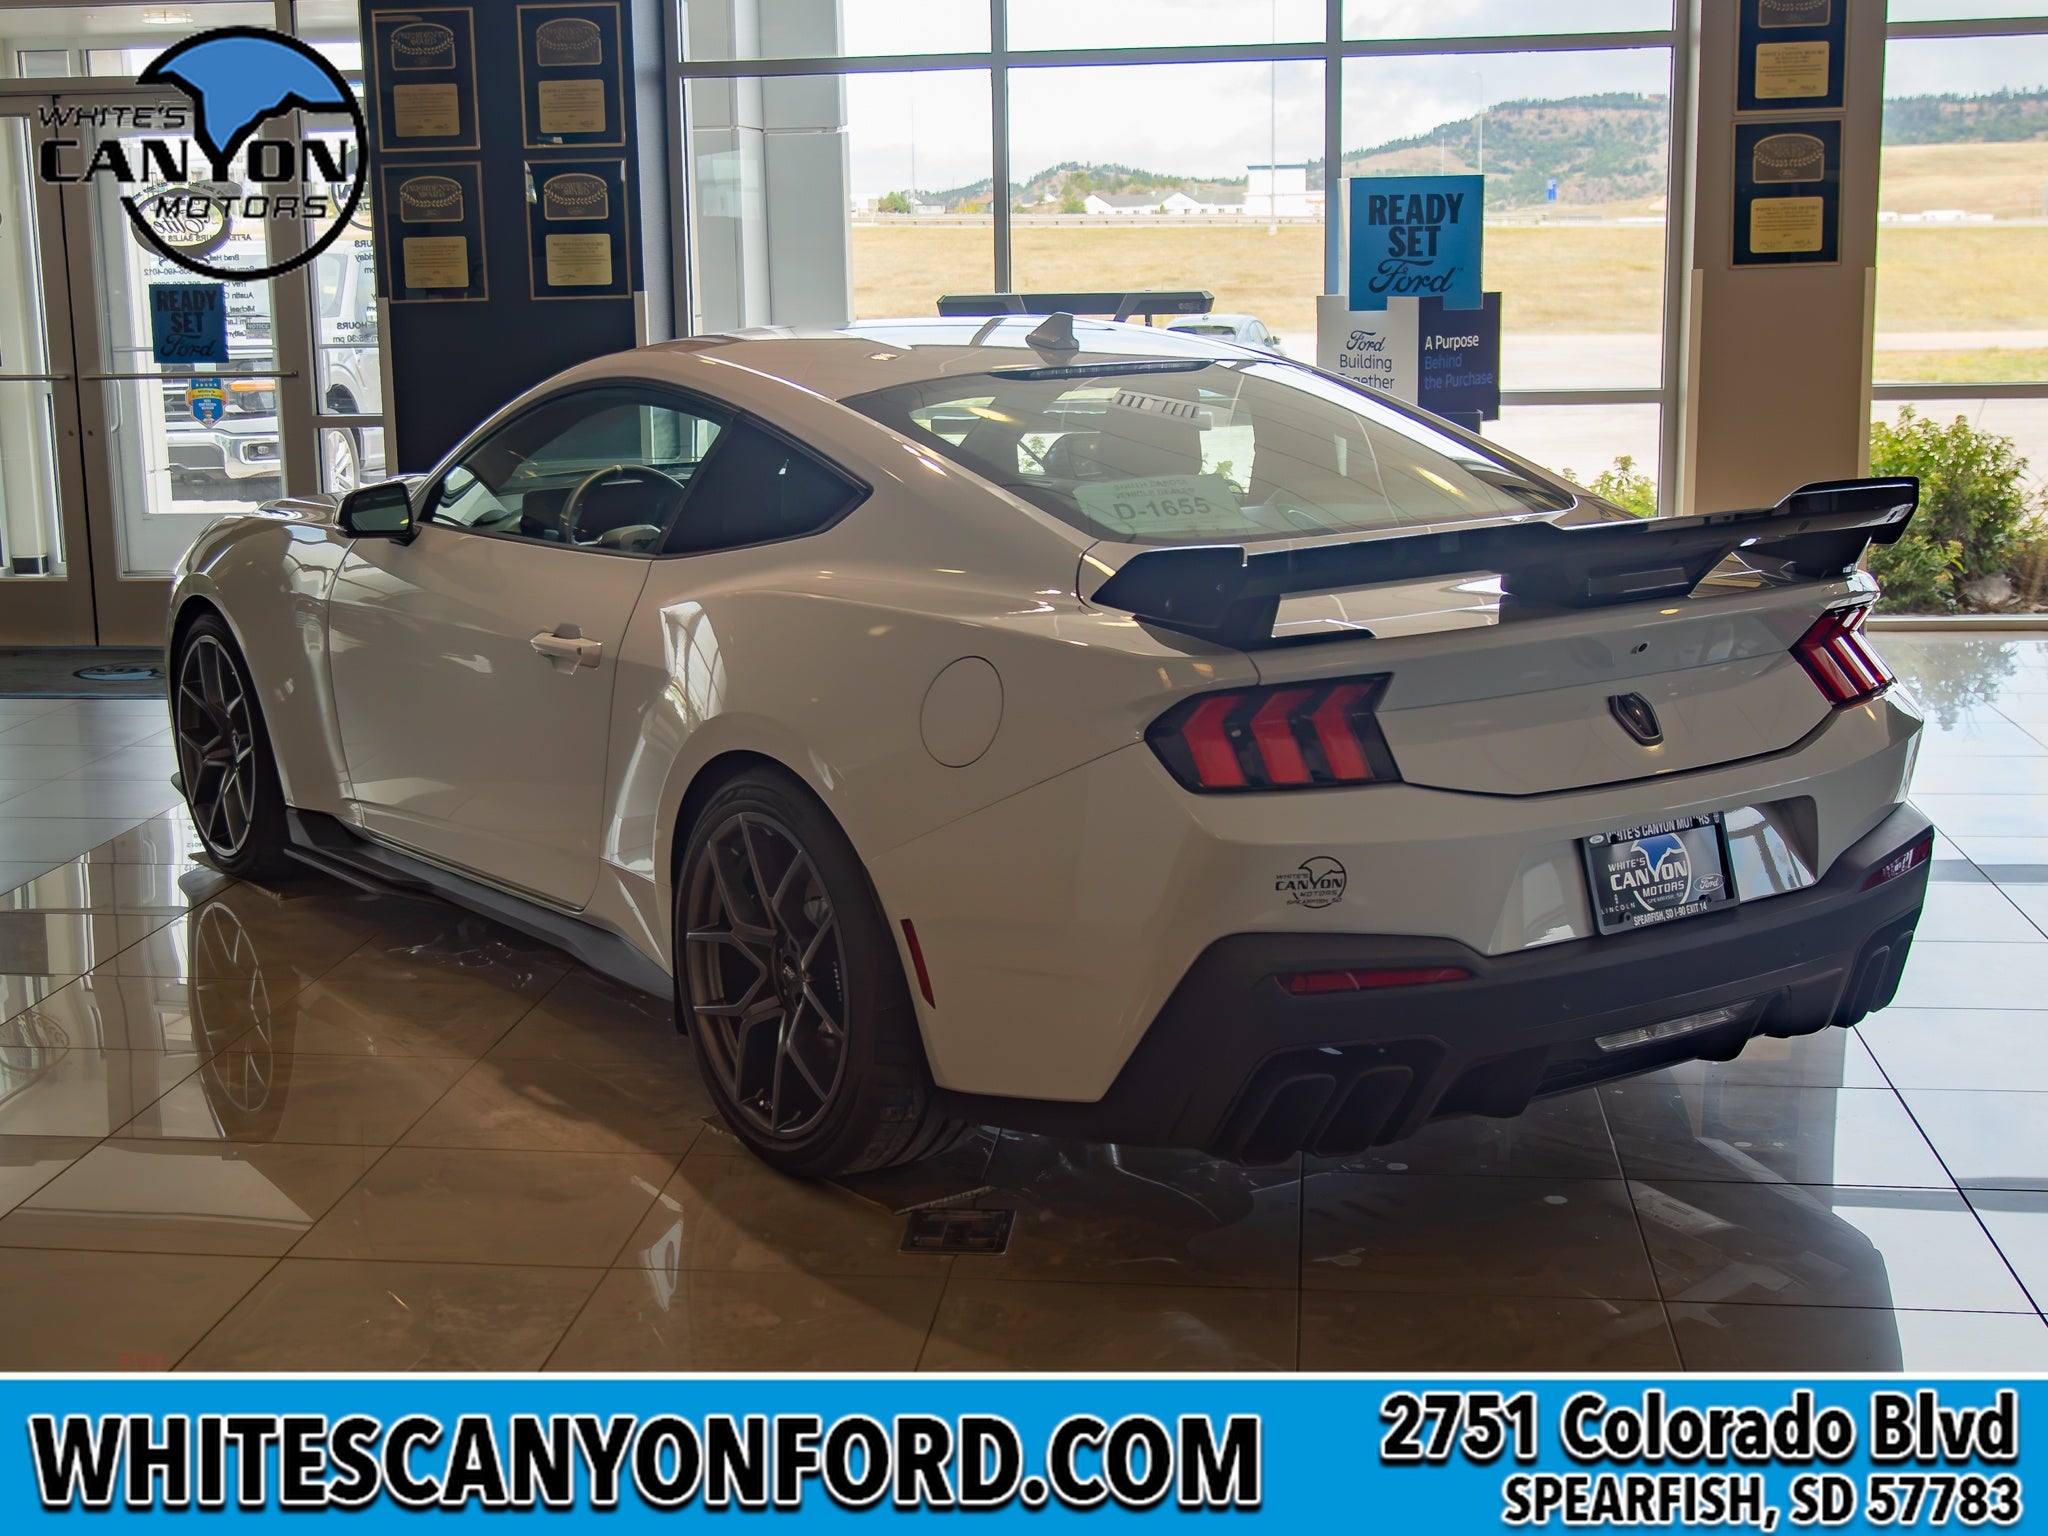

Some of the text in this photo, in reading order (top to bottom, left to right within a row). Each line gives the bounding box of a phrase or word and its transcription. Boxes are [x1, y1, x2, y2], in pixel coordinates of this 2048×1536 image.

[1368, 193, 1465, 225] READY
[1388, 225, 1441, 257] SET
[1368, 258, 1456, 293] Ford
[156, 290, 217, 311] READY
[170, 312, 205, 333] SET
[160, 333, 216, 358] Ford
[1346, 330, 1385, 352] Ford
[1425, 333, 1480, 351] A Purpose
[1340, 354, 1392, 373] Building
[1425, 353, 1462, 370] Behind
[1425, 371, 1493, 390] the Purchase
[1113, 497, 1211, 520] D-1655
[1608, 857, 1646, 872] WHITE'S
[1275, 878, 1343, 891] CANYON
[1610, 860, 1688, 891] CANYON
[1699, 876, 1719, 889] Ford
[1642, 881, 1685, 898] MOTORS
[1601, 902, 1636, 915] LINCOLN
[1686, 904, 1699, 915] EXIT
[1699, 901, 1708, 912] 14
